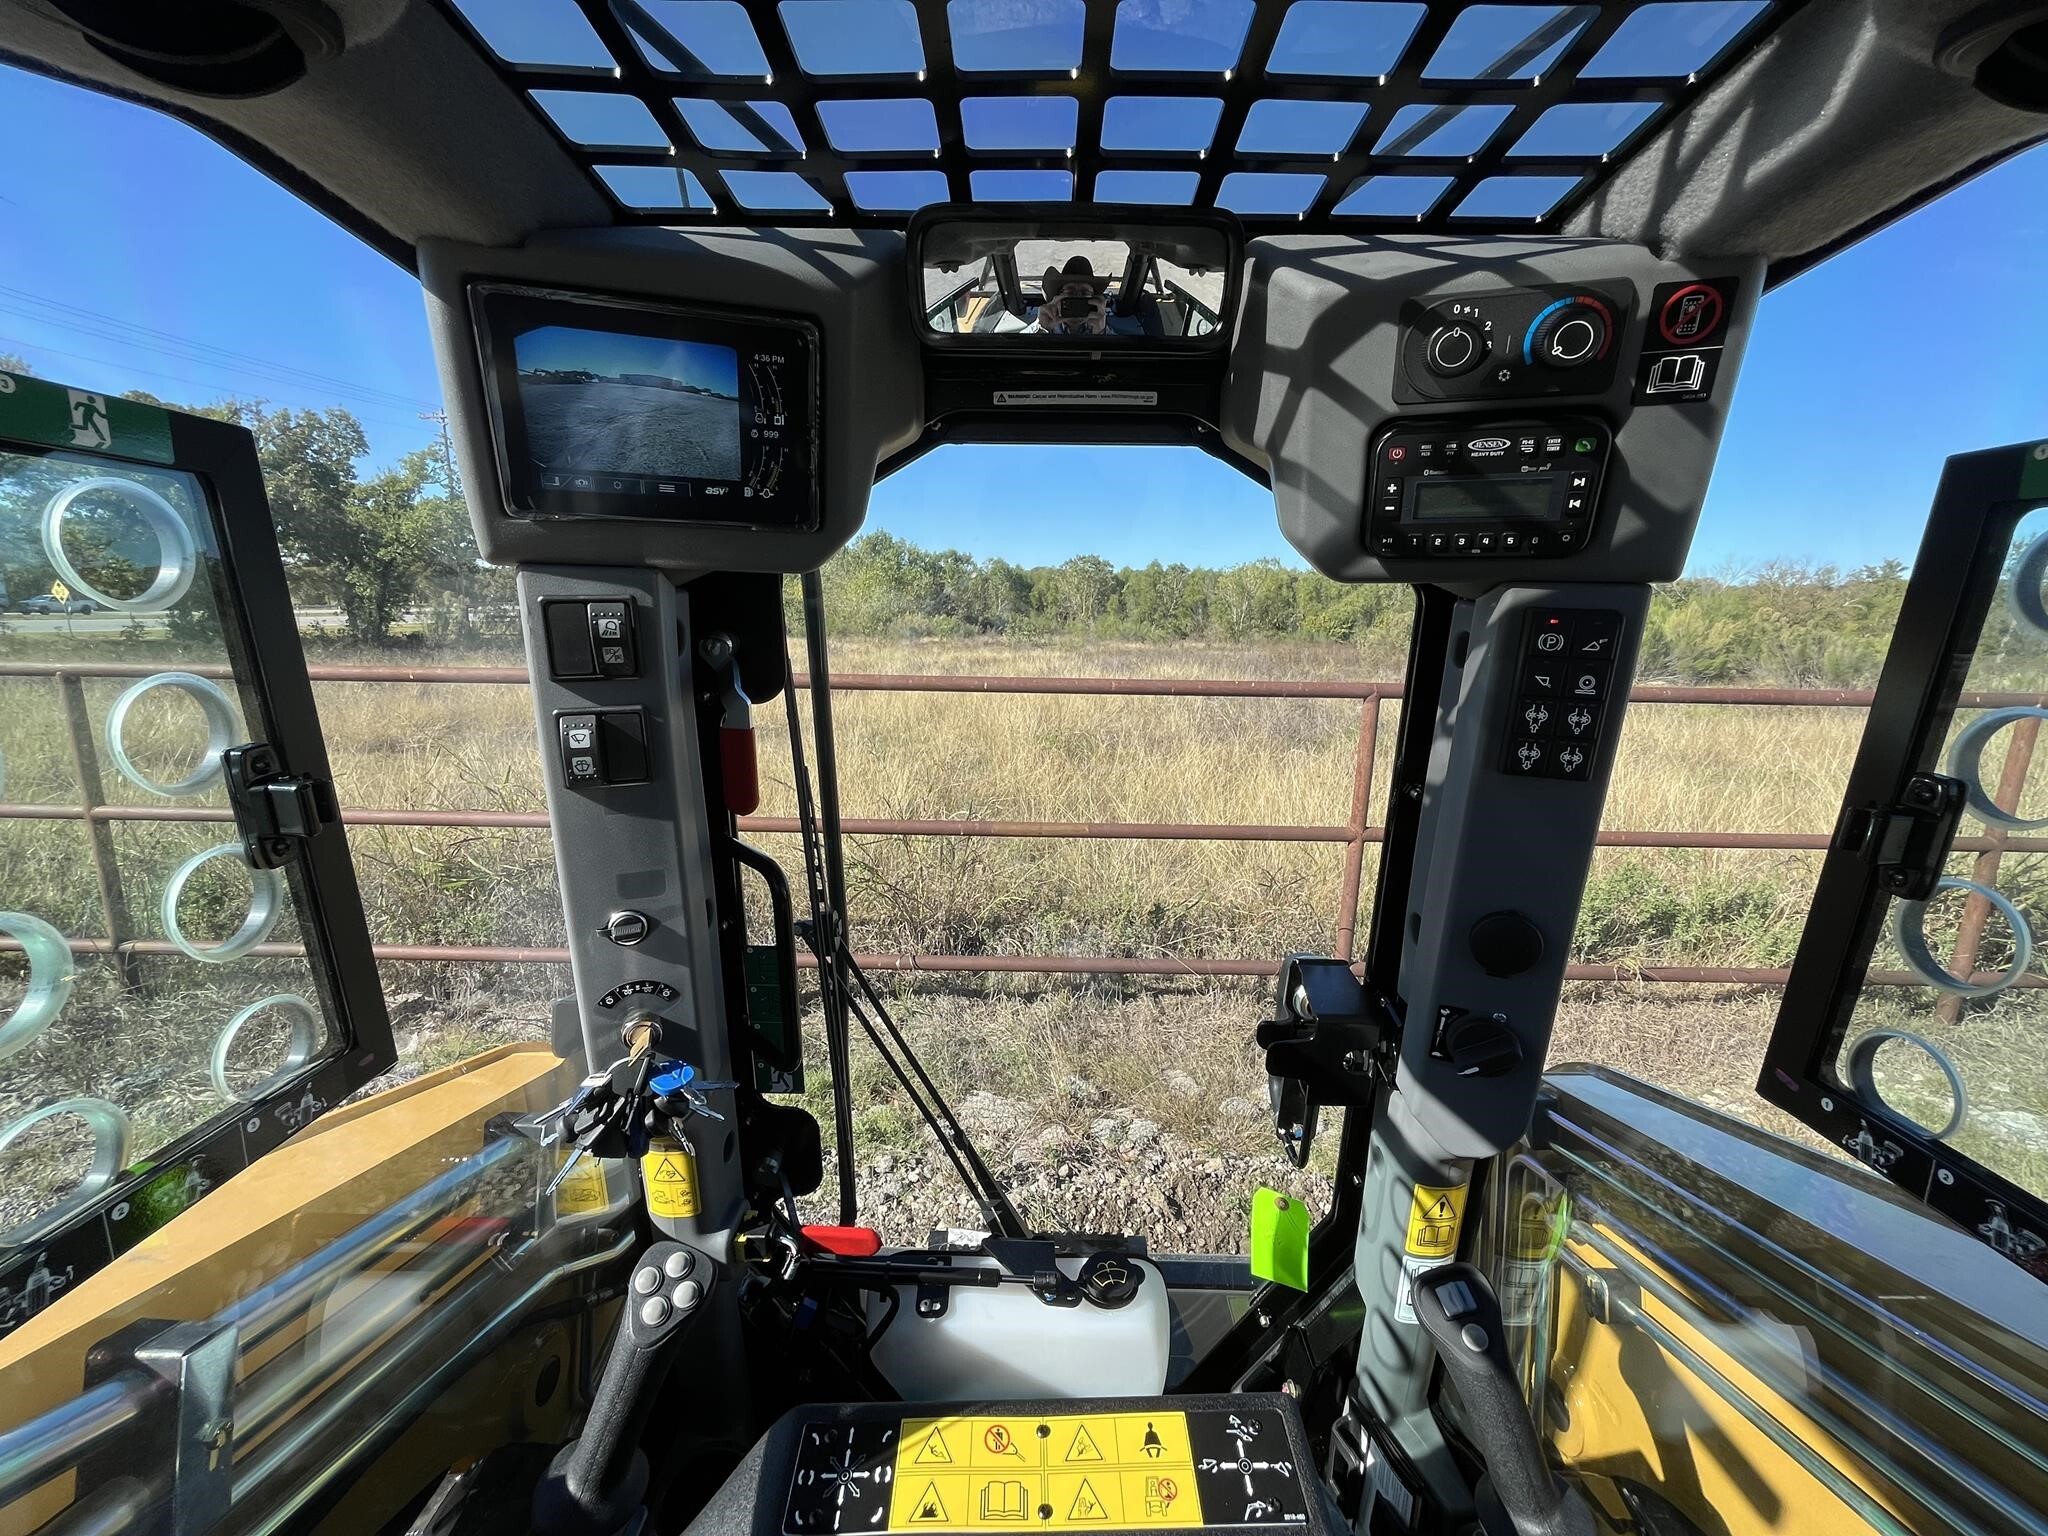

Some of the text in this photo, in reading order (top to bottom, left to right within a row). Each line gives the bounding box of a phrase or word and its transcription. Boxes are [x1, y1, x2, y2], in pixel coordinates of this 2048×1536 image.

[772, 355, 785, 364] PM
[1473, 439, 1505, 449] JENSEN
[1434, 538, 1442, 546] 2
[1458, 538, 1466, 546] 3
[1482, 537, 1490, 545] 4
[1507, 537, 1514, 545] 5
